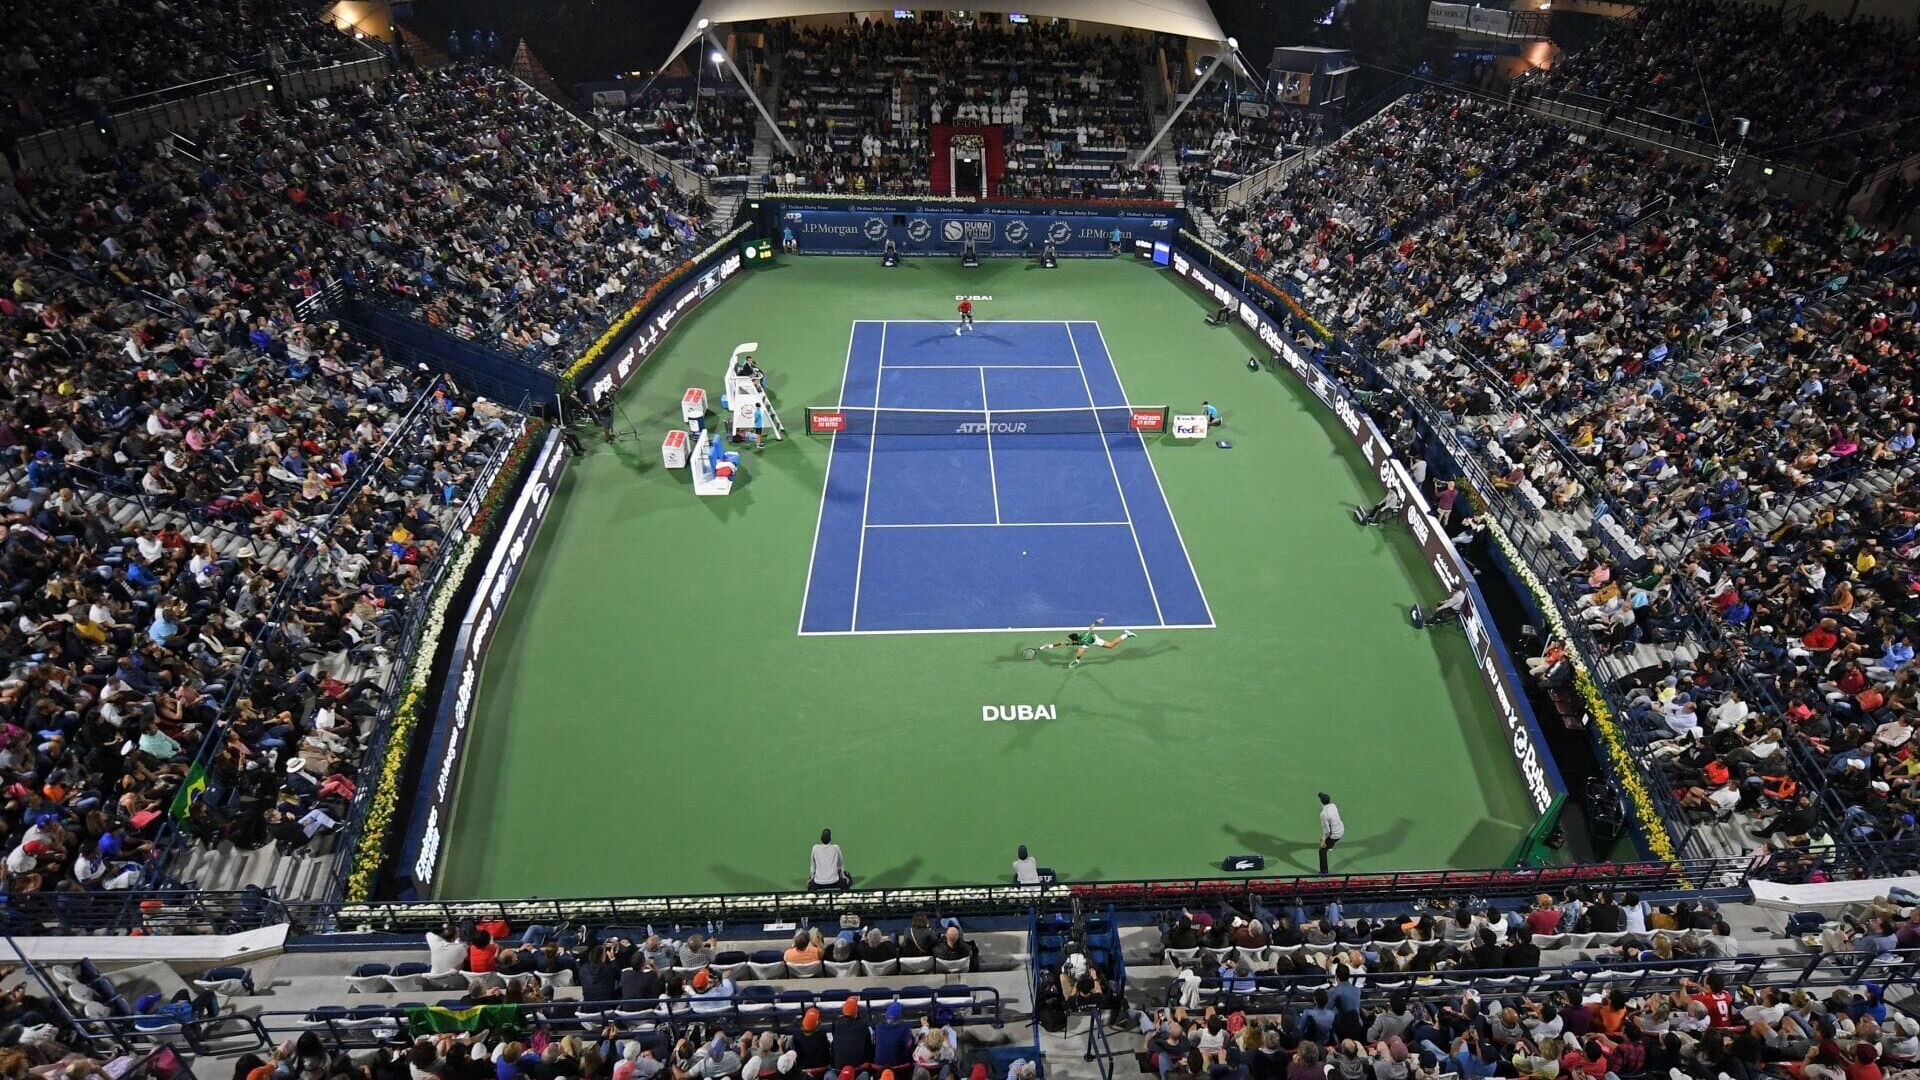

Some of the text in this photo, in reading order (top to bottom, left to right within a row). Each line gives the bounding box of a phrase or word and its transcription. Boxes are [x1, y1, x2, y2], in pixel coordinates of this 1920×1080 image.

[783, 212, 802, 221] ATP
[802, 223, 859, 237] J.P.Morgan
[964, 221, 992, 229] DUBAI
[1150, 220, 1168, 228] ATP
[1078, 228, 1132, 240] J.P.Moran
[956, 422, 1027, 434] ATP TOUR
[1177, 425, 1205, 435] FedEx
[982, 704, 1057, 721] DUBAI
[1526, 742, 1552, 809] Dubai
[415, 804, 438, 881] Emirates
